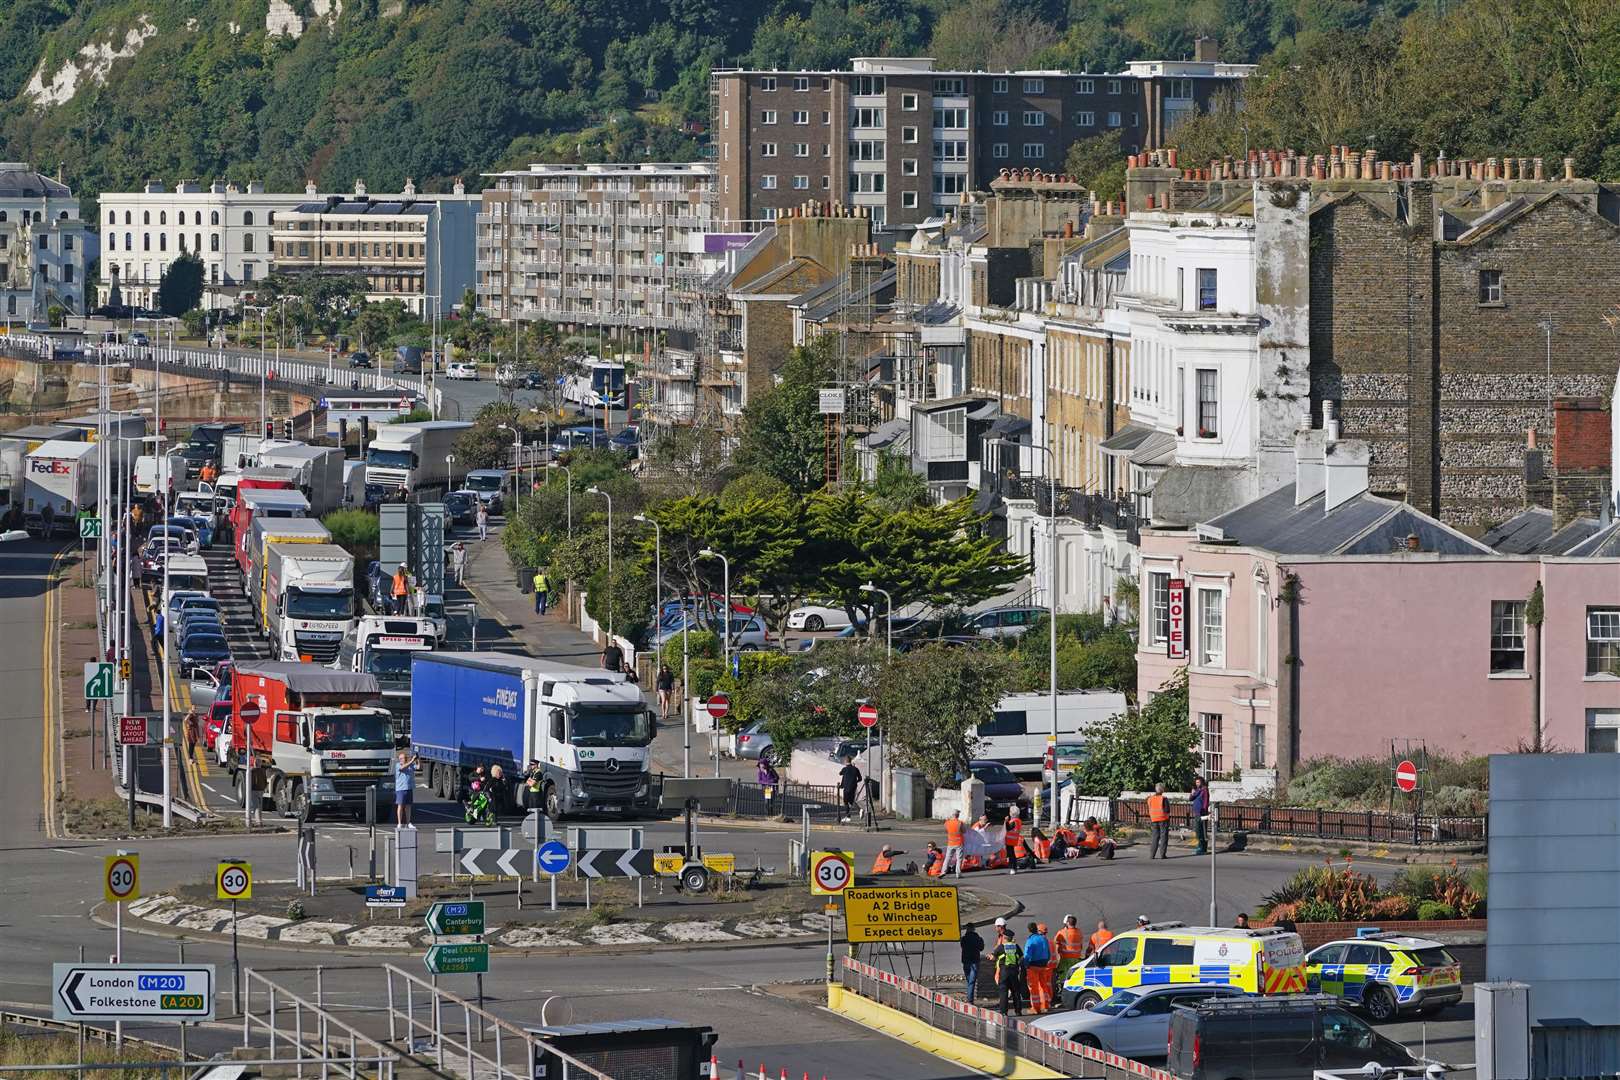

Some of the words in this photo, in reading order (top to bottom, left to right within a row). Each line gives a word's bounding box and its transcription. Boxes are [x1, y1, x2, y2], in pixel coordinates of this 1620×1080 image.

[31, 461, 70, 474] FedEx
[1171, 592, 1182, 655] HOTEL
[112, 871, 132, 886] 30
[820, 866, 846, 881] 30
[225, 875, 245, 887] 30
[848, 890, 908, 899] Roadworks
[910, 890, 920, 898] in
[922, 889, 953, 899] place
[447, 906, 466, 914] (M2)
[872, 901, 889, 910] A2
[894, 901, 930, 911] Bridge
[868, 913, 879, 922] to
[883, 913, 938, 922] Wincheap
[864, 928, 904, 938] Expect
[907, 927, 943, 938] delays
[1268, 947, 1303, 958] POLICE
[90, 977, 134, 988] London
[141, 976, 183, 989] (M20)
[90, 996, 157, 1007] Folkestone
[162, 995, 202, 1008] (A20)
